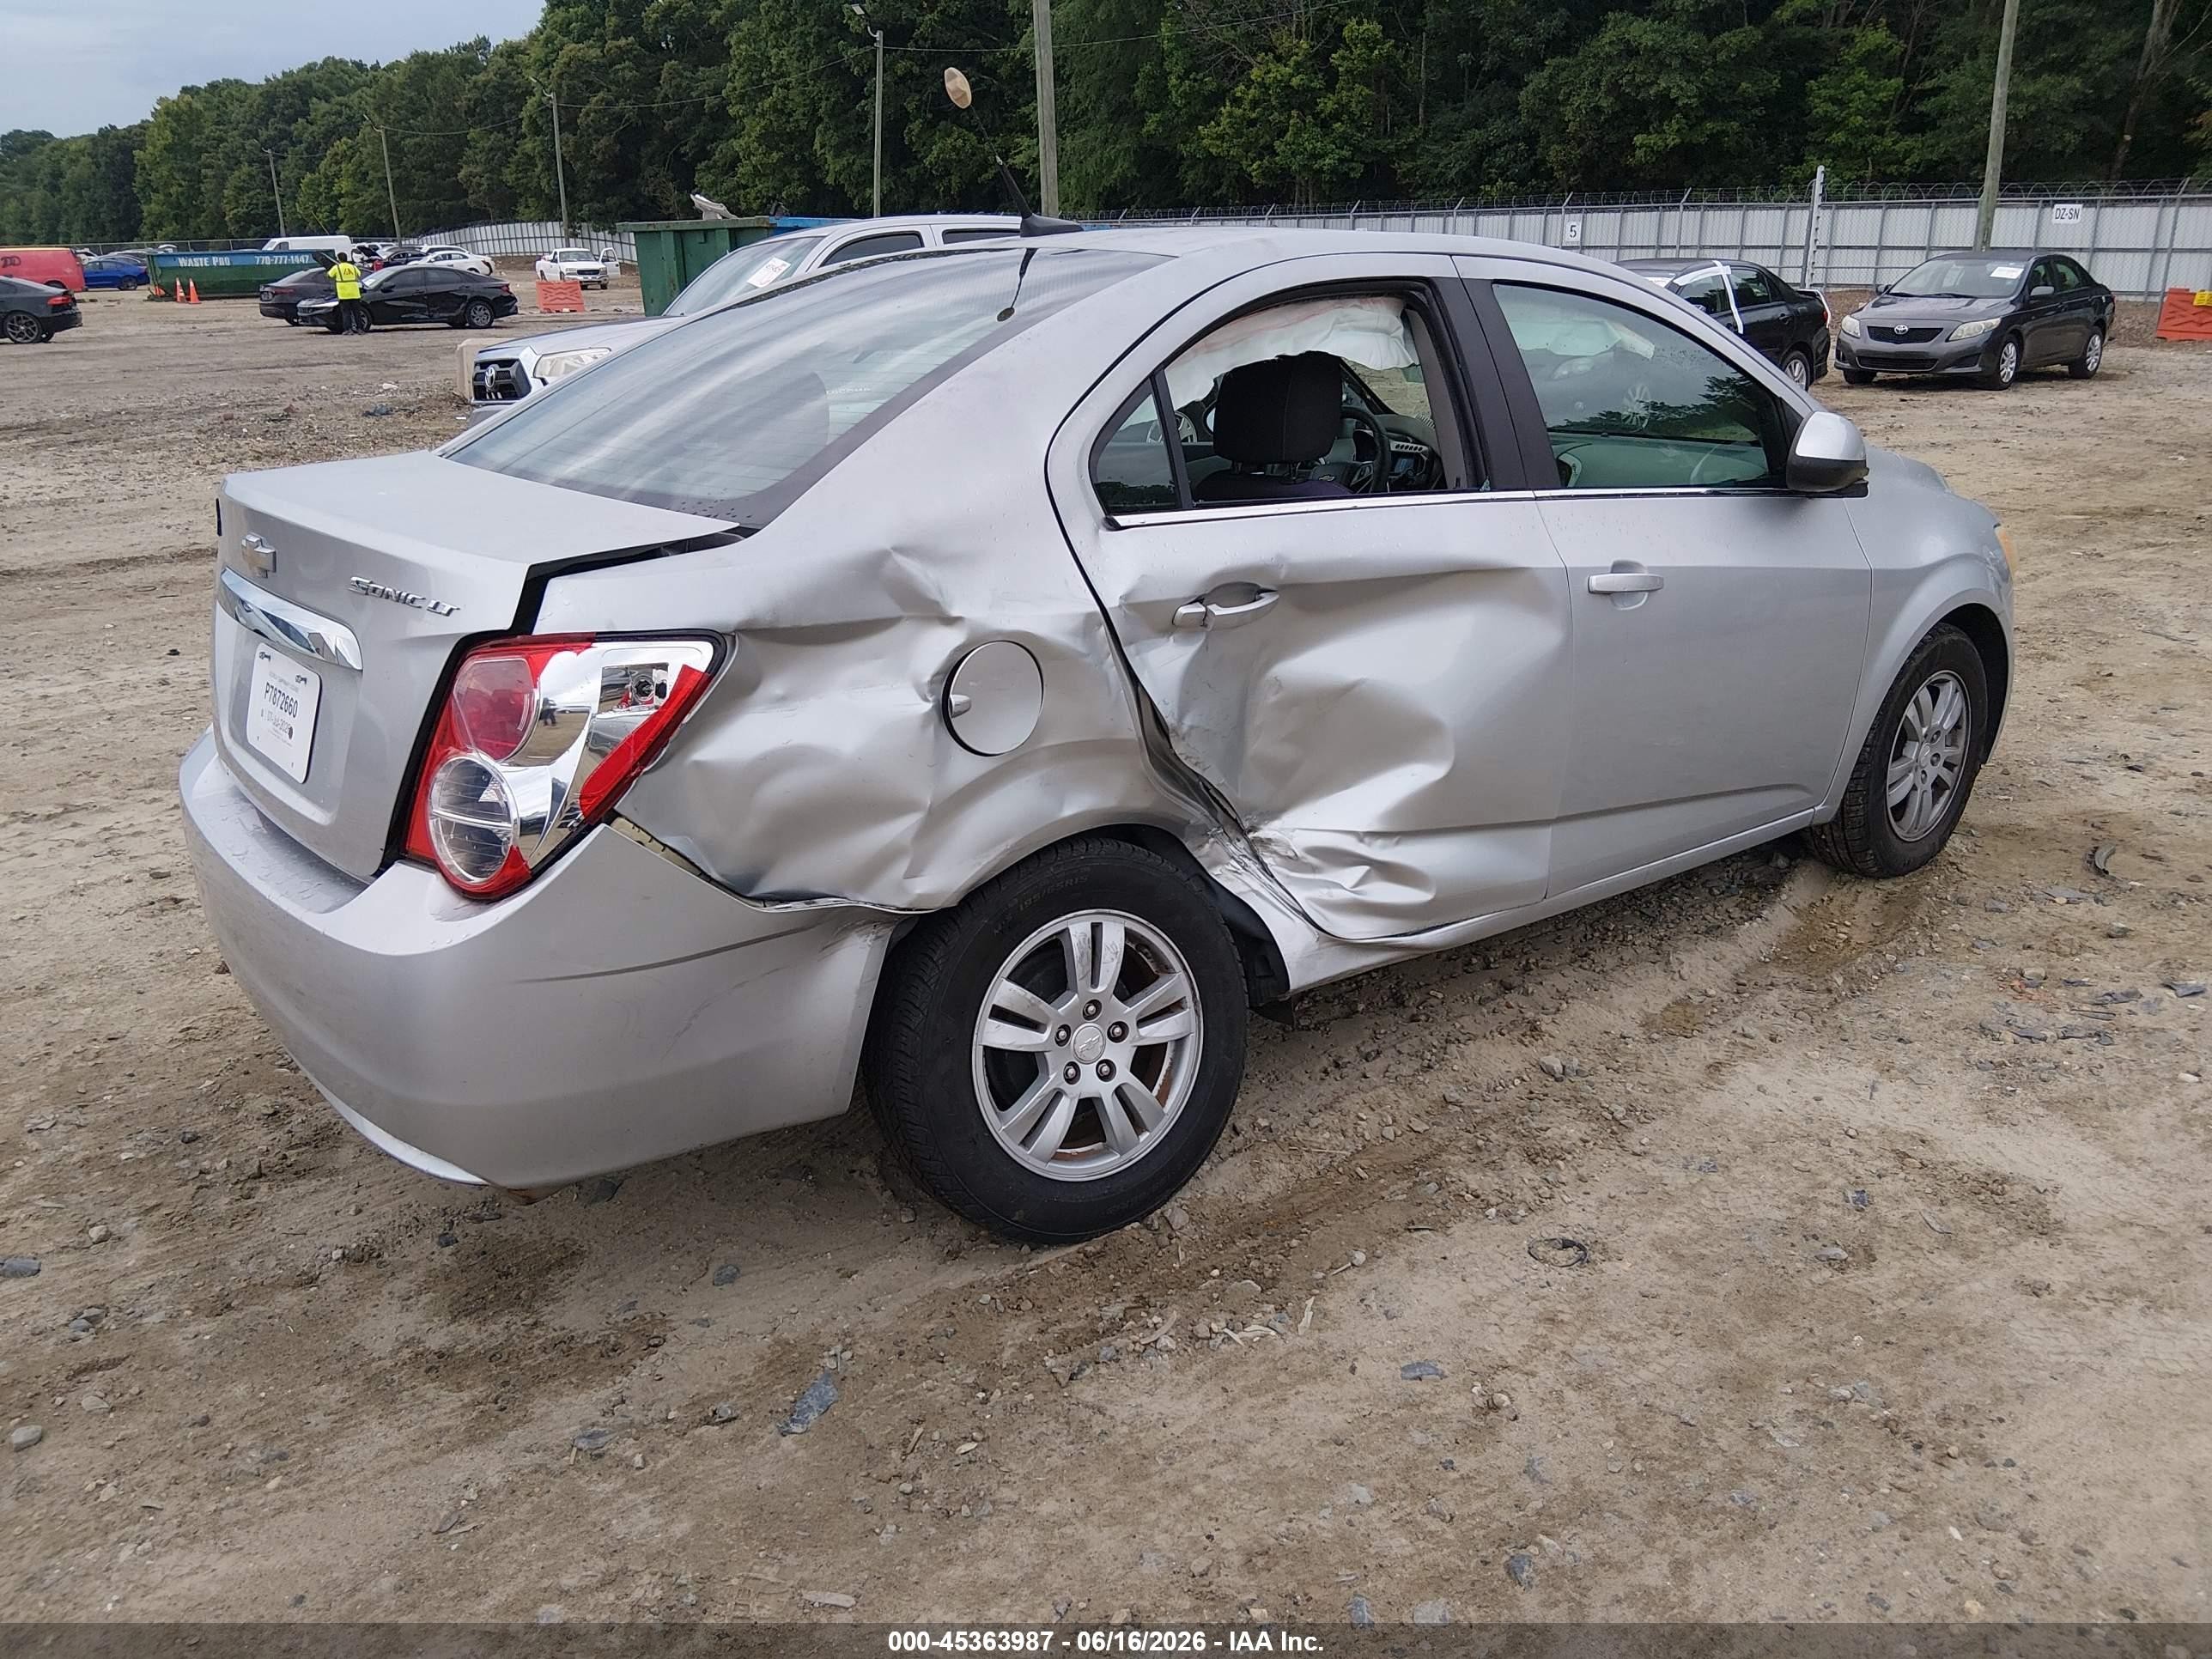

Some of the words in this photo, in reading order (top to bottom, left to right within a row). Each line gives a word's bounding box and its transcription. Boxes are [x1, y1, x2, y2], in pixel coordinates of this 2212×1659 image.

[2055, 207, 2081, 221] DZ-SN
[1569, 224, 1577, 238] 5
[178, 257, 210, 267] WASTE
[347, 576, 427, 609] SONIC
[426, 599, 461, 617] LT
[264, 681, 299, 719] P7872660
